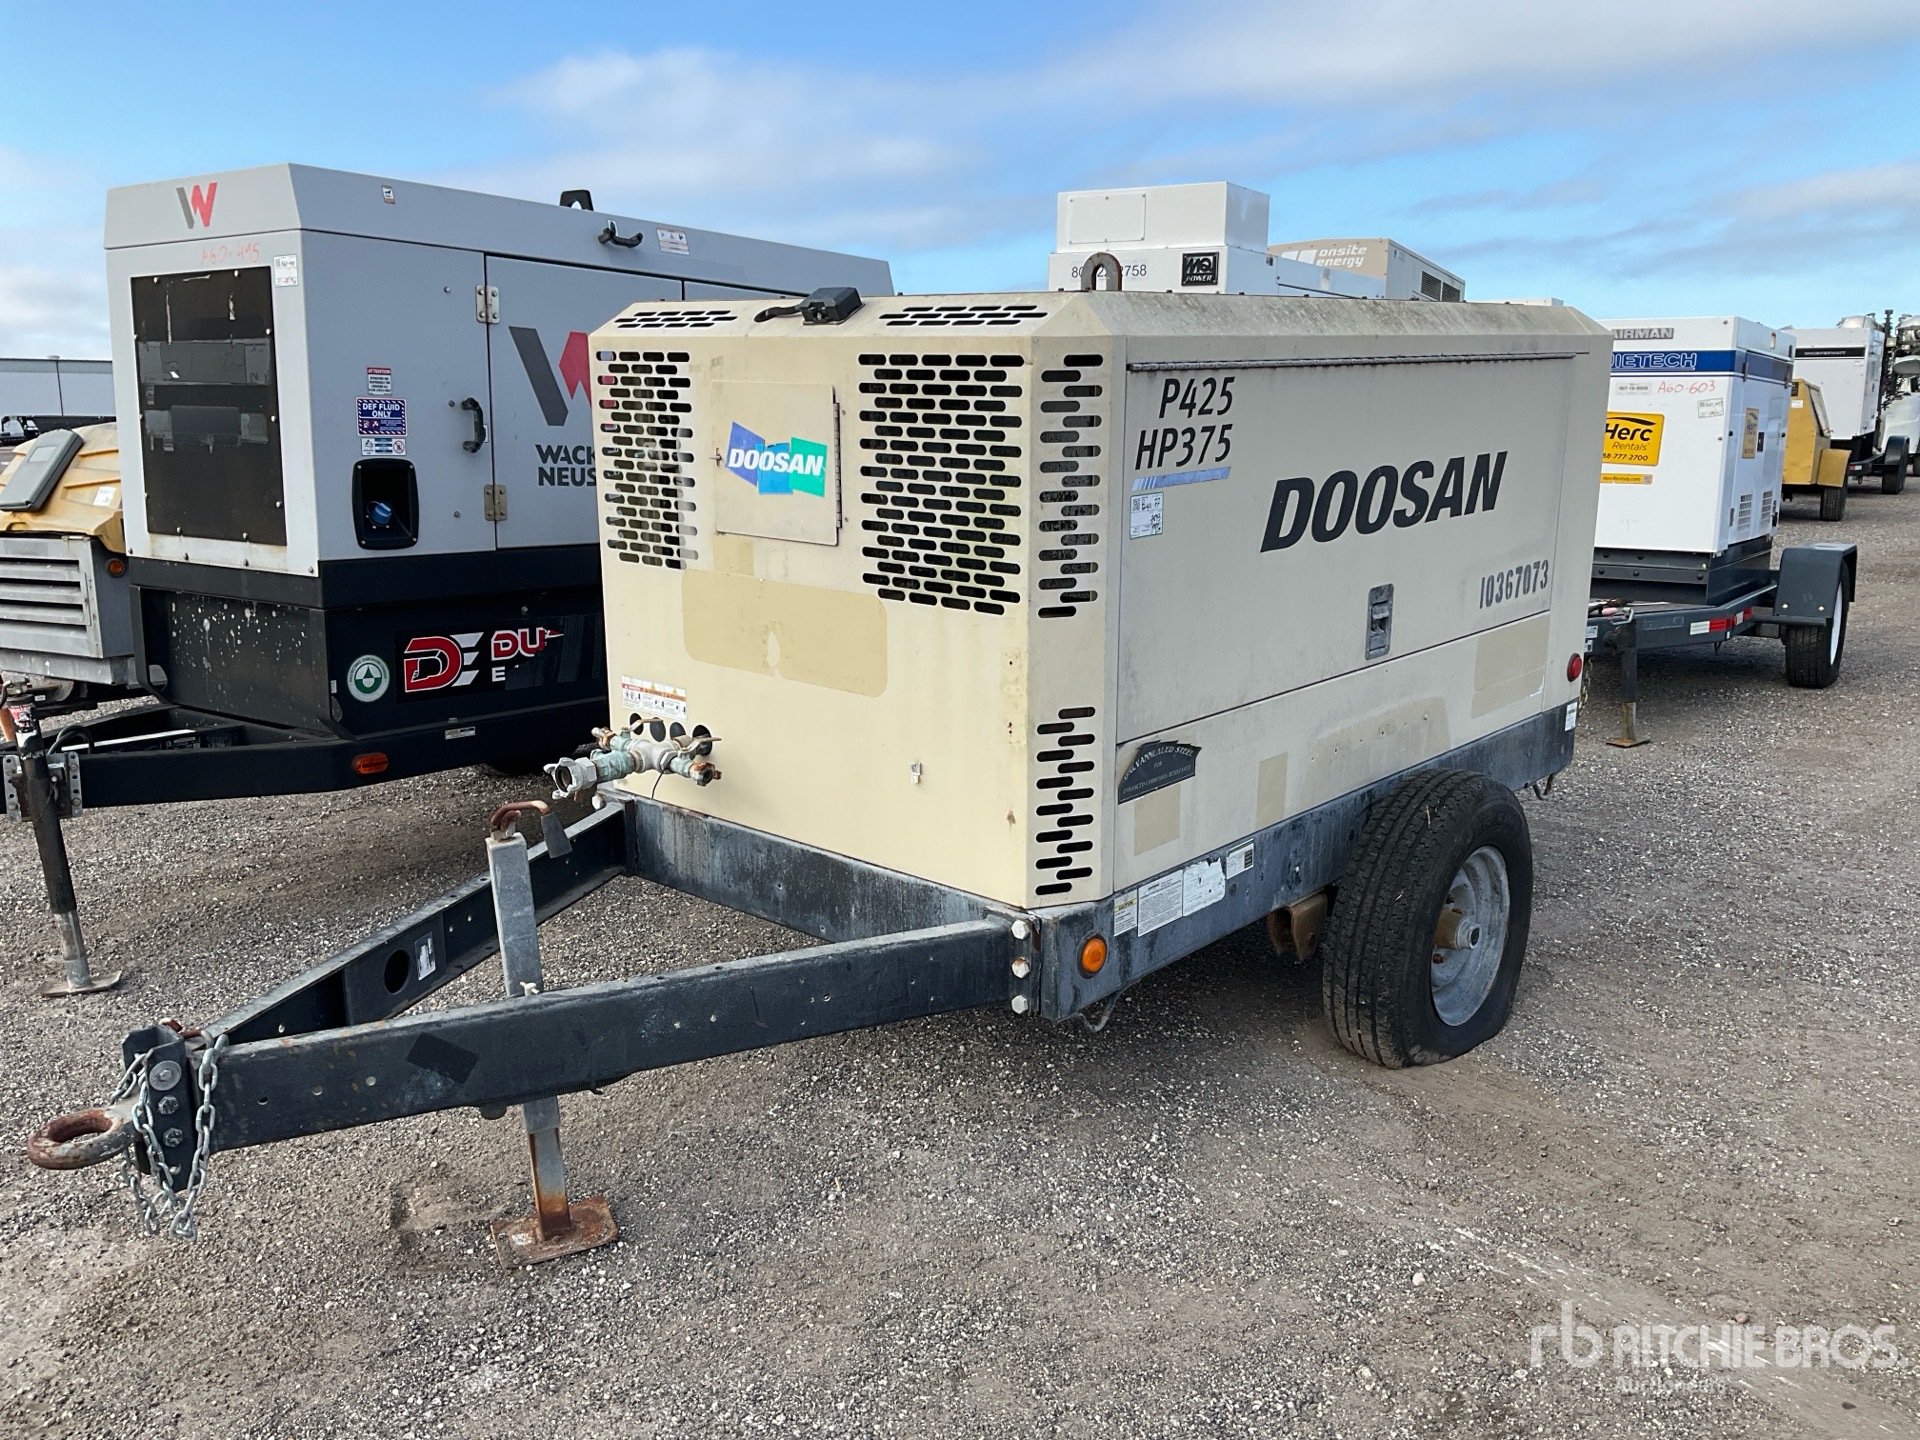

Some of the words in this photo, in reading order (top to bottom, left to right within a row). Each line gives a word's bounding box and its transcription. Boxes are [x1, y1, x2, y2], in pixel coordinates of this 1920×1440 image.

[1319, 244, 1367, 257] onsite
[1316, 256, 1364, 268] energy
[1159, 376, 1235, 418] P425
[362, 403, 377, 411] DEF
[371, 410, 392, 418] ONLY
[1605, 423, 1653, 442] Herc
[1135, 423, 1233, 470] HP375
[1612, 441, 1647, 451] Rentals
[728, 448, 825, 476] DOOSAN
[1260, 451, 1508, 553] DOOSAN
